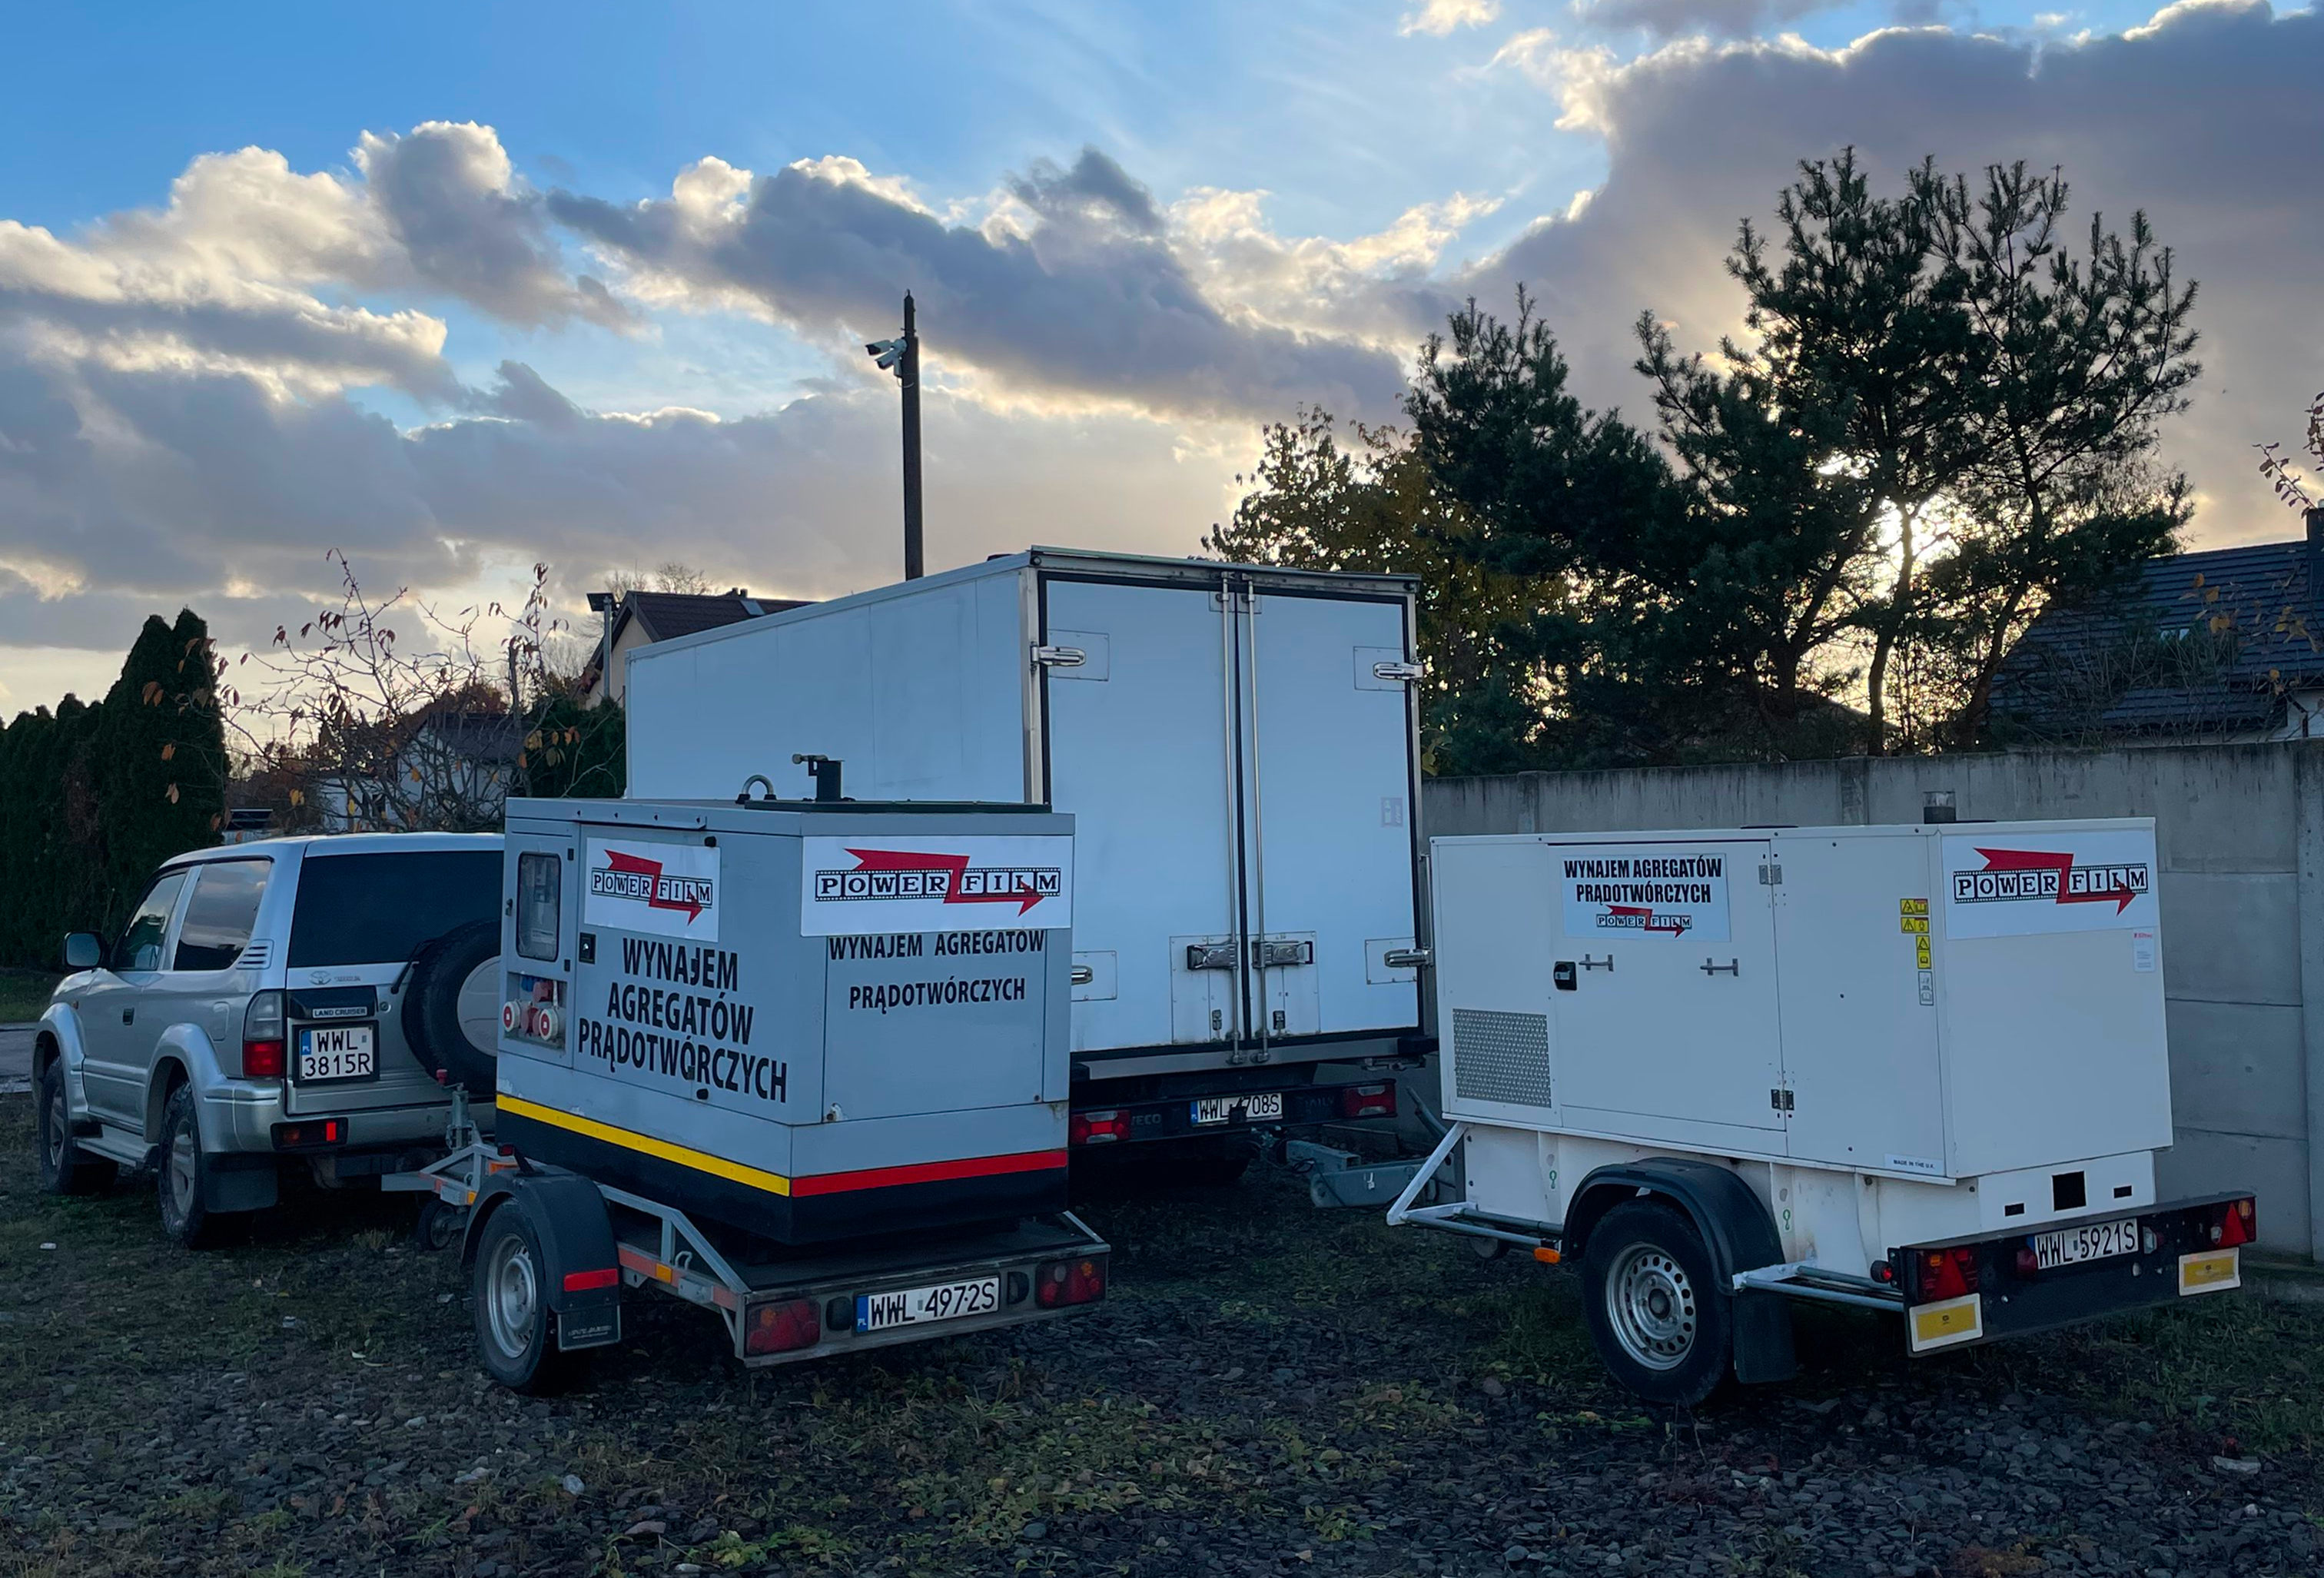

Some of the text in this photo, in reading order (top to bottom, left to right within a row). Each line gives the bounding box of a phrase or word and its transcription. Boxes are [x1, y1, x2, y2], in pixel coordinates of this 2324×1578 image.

[1563, 855, 1721, 878] WYNAJEM AGREGATÓW
[594, 874, 712, 903] POWER FILM
[821, 874, 1057, 895] POWER FILM
[1576, 881, 1711, 905] PRĄDOTWÓRCZYCH
[1958, 870, 2146, 895] POWER FILM
[1599, 916, 1691, 927] POWER FILM
[829, 934, 923, 961] WYNAJEM
[622, 937, 738, 992] WYNAJEM
[849, 976, 1025, 1015] PRĄDOTWÓRCZYCH
[607, 982, 754, 1045] AGREGATÓW
[316, 1030, 358, 1053] WWL
[304, 1053, 370, 1078] 3815R
[579, 1018, 788, 1103] PRĄDOTWÓRCZYCH
[1199, 1098, 1229, 1120] WWL
[2037, 1222, 2135, 1267] WWL 5921S
[871, 1294, 915, 1327] WWL
[925, 1281, 995, 1317] 4972S
